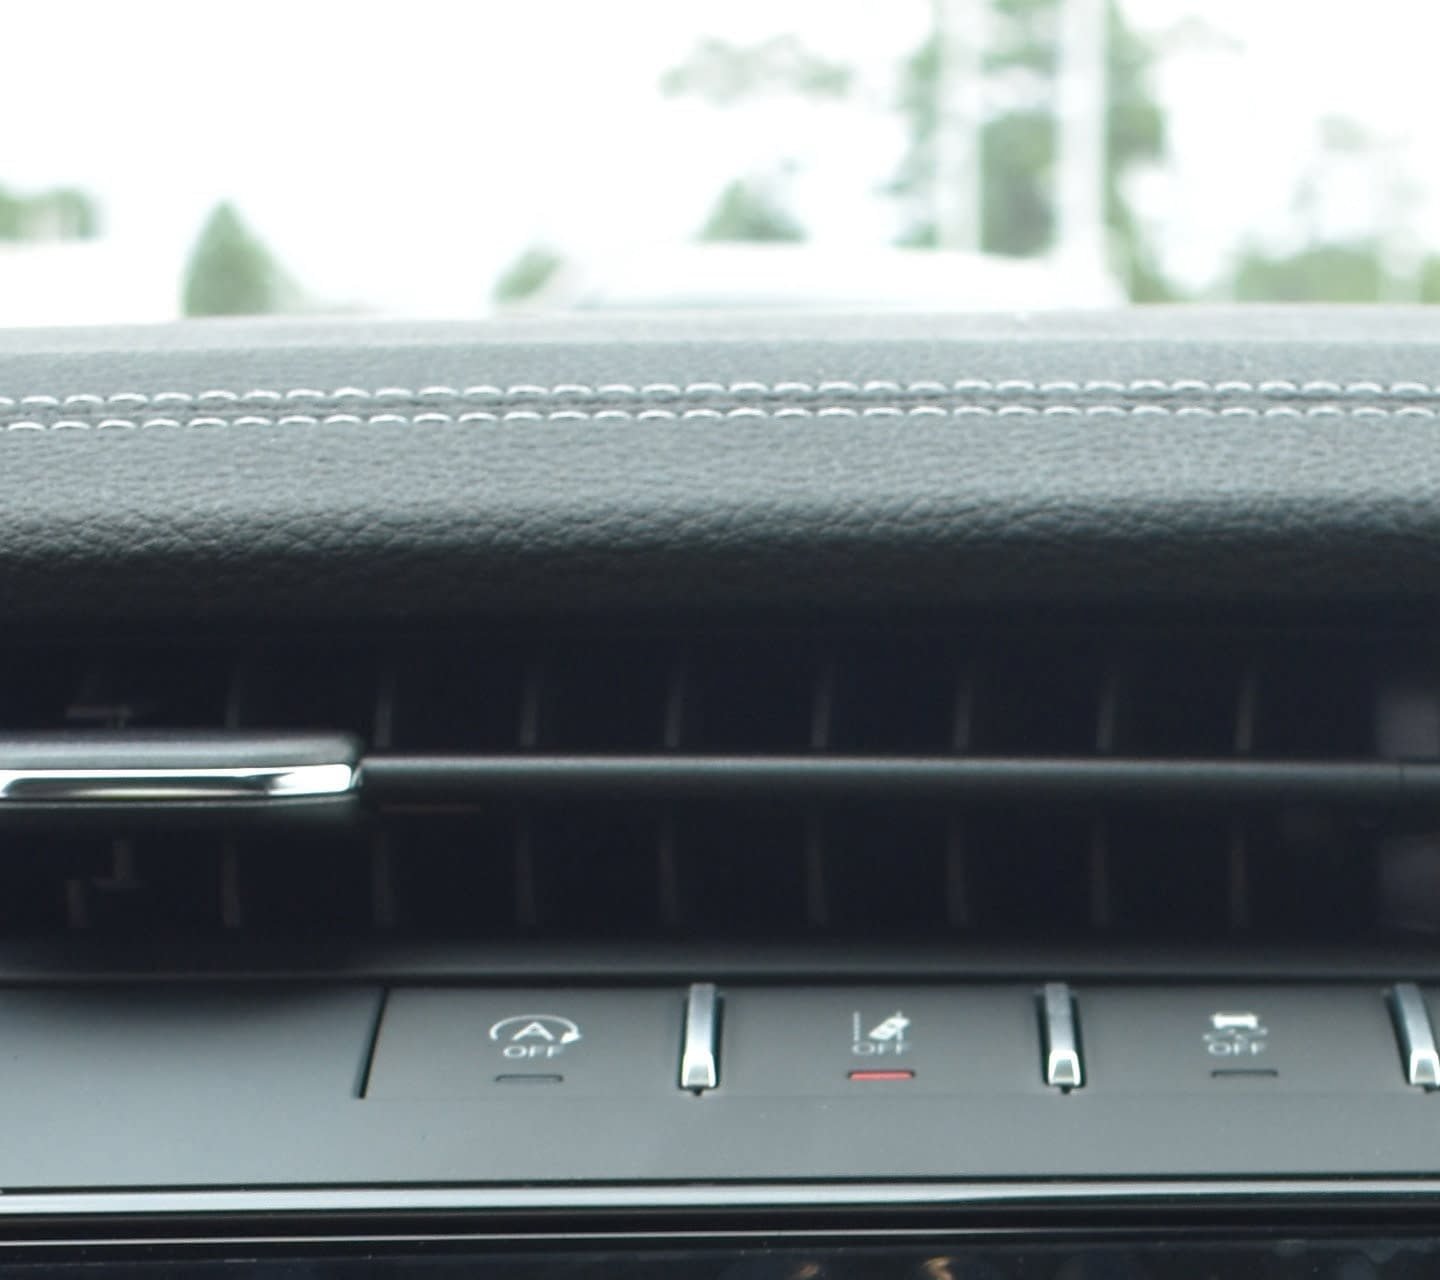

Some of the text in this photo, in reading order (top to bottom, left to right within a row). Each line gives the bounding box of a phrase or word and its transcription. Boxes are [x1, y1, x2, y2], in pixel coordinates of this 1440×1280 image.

[502, 1045, 564, 1058] OFF
[851, 1042, 911, 1055] OFF
[1207, 1042, 1266, 1055] OFF
